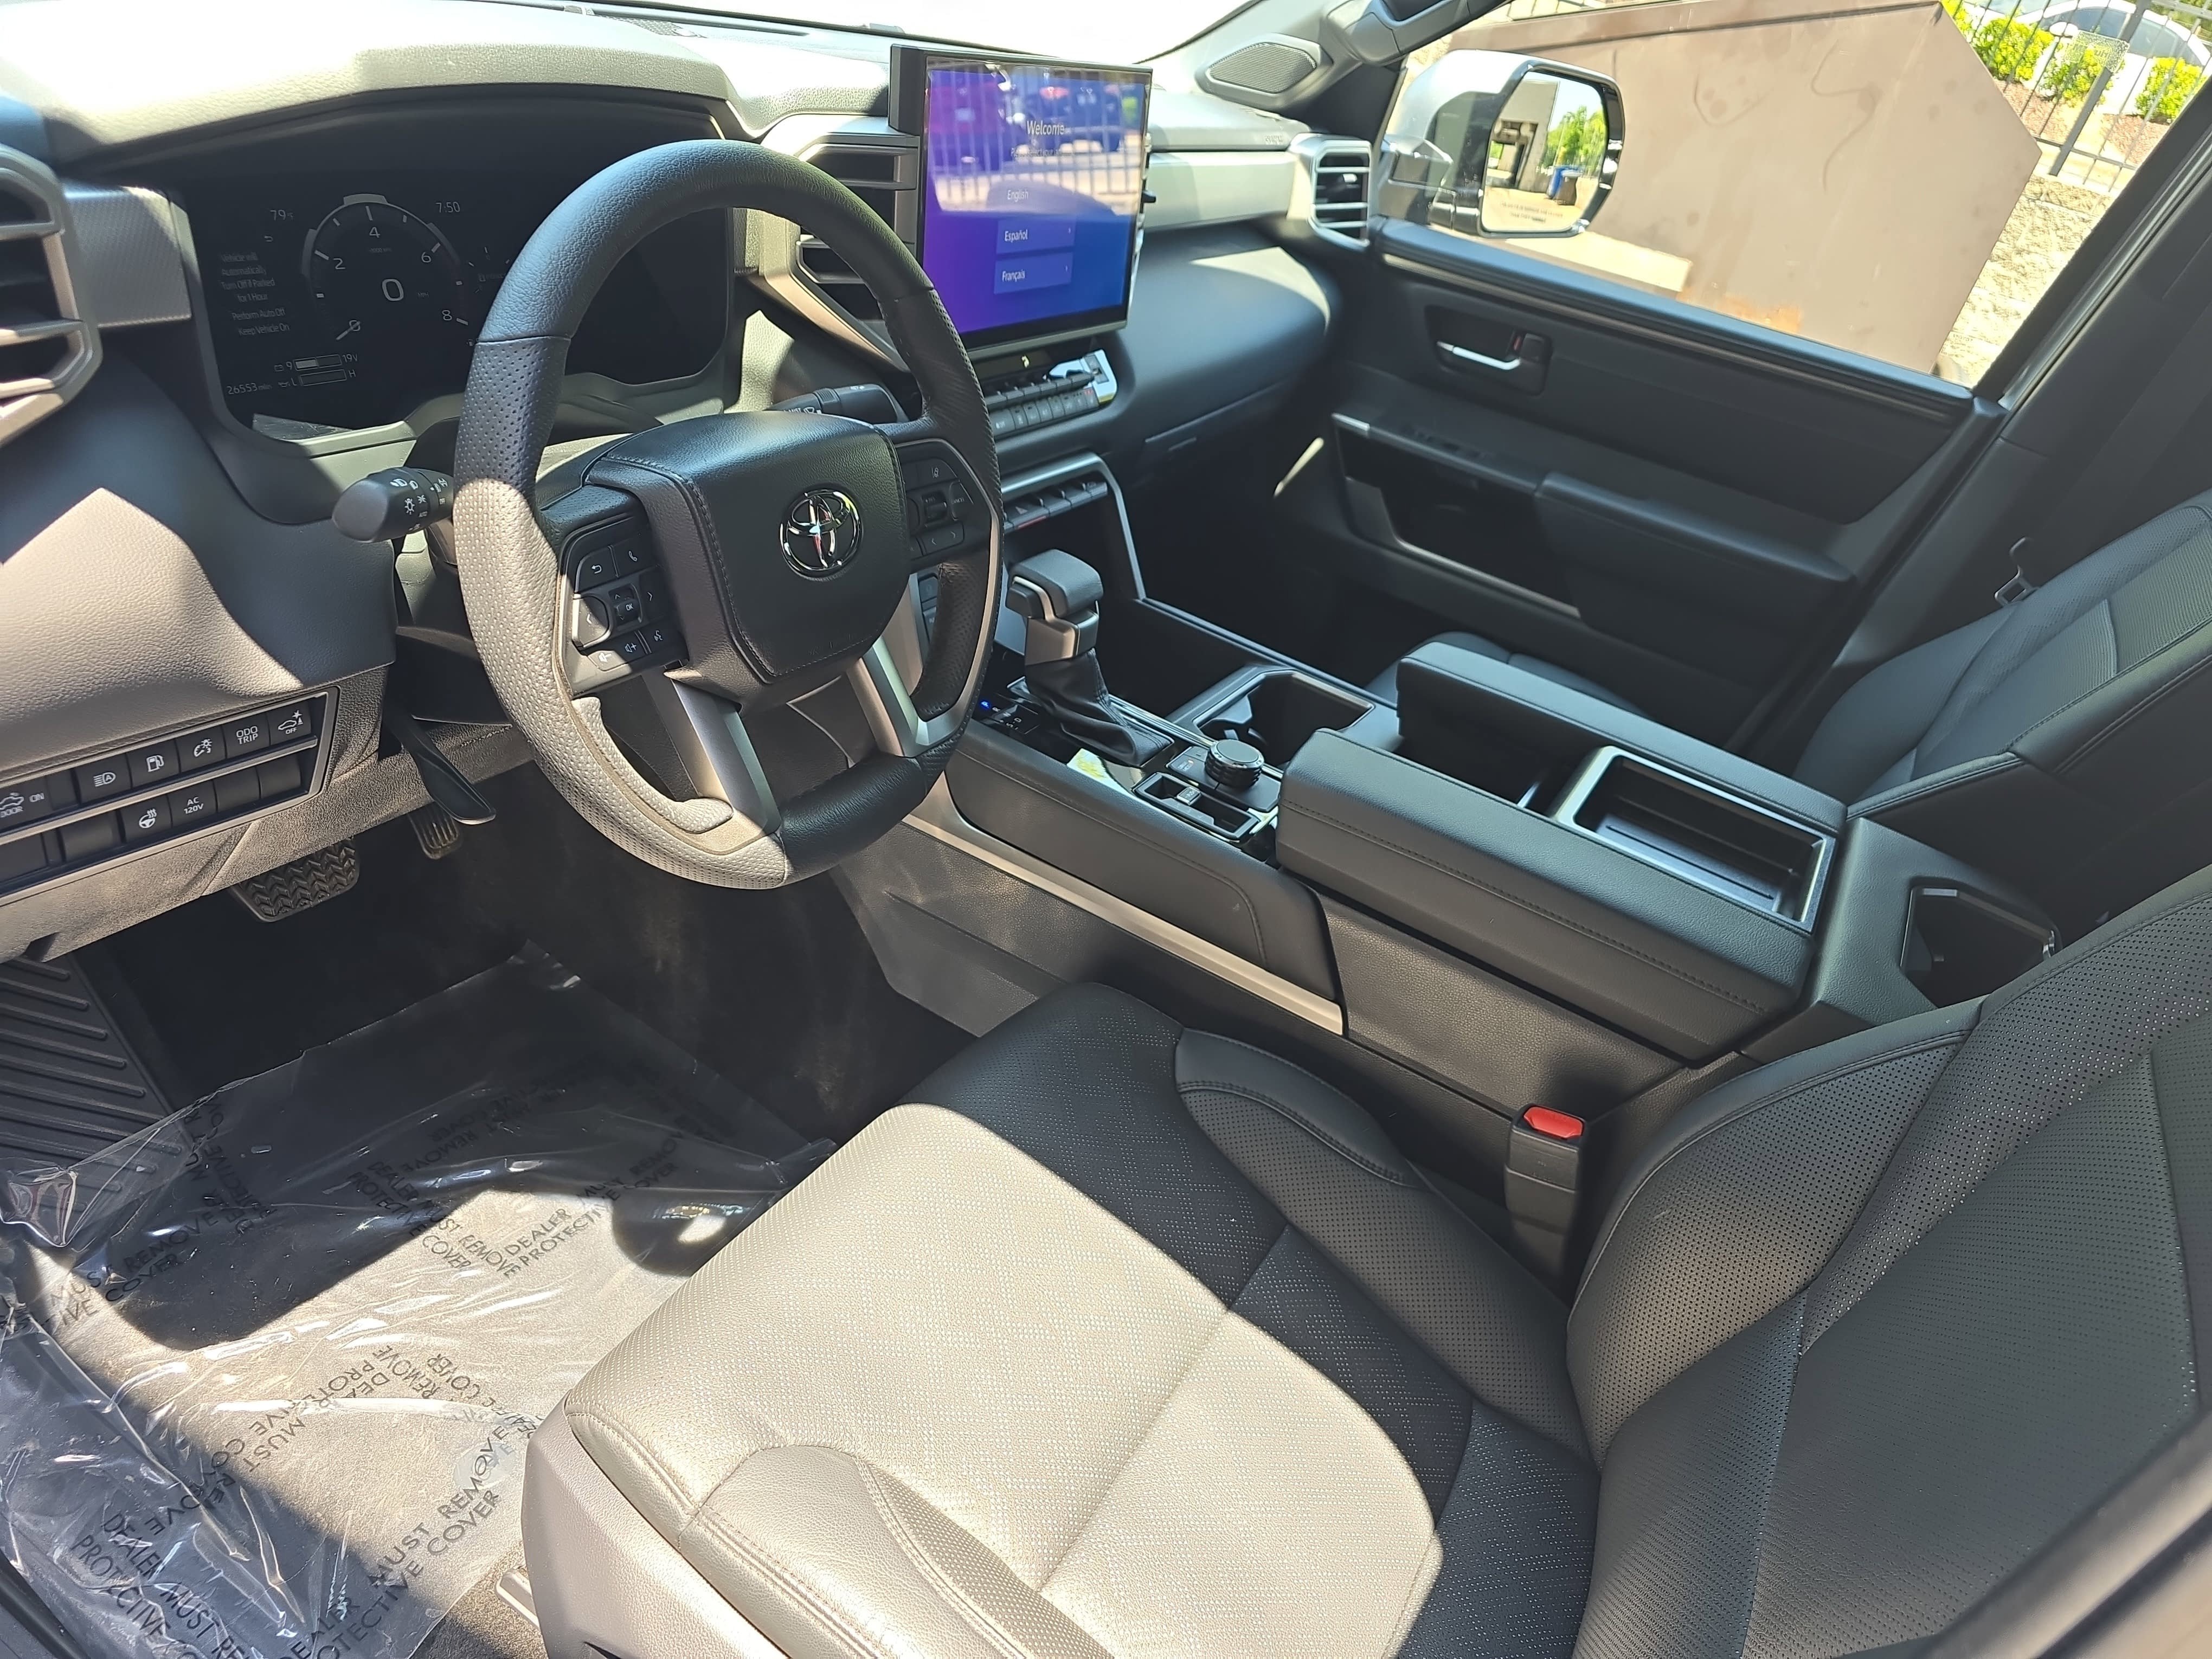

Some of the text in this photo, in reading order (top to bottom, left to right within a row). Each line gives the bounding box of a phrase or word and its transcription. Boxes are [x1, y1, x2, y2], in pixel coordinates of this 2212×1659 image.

[1026, 120, 1064, 135] Welcome
[1007, 190, 1029, 202] English
[435, 202, 460, 213] 7:50
[369, 227, 381, 238] 4
[1005, 229, 1028, 243] Español
[333, 258, 345, 269] 2
[421, 252, 432, 263] 6
[1001, 269, 1025, 282] Français
[382, 279, 404, 301] 0
[442, 310, 453, 321] 8
[286, 361, 293, 370] 9
[349, 369, 356, 377] H
[227, 383, 258, 395] 26553
[236, 726, 258, 738] ODO
[237, 733, 259, 744] TRIP
[29, 792, 45, 802] ON
[187, 796, 200, 805] AC
[183, 803, 204, 814] 120V
[505, 1208, 571, 1256] DEALER
[422, 1234, 473, 1270] COVER
[459, 1232, 522, 1279] REMOVE
[242, 1417, 306, 1472] MUST
[437, 1425, 511, 1521] REMOVE
[428, 1489, 500, 1555] COVER
